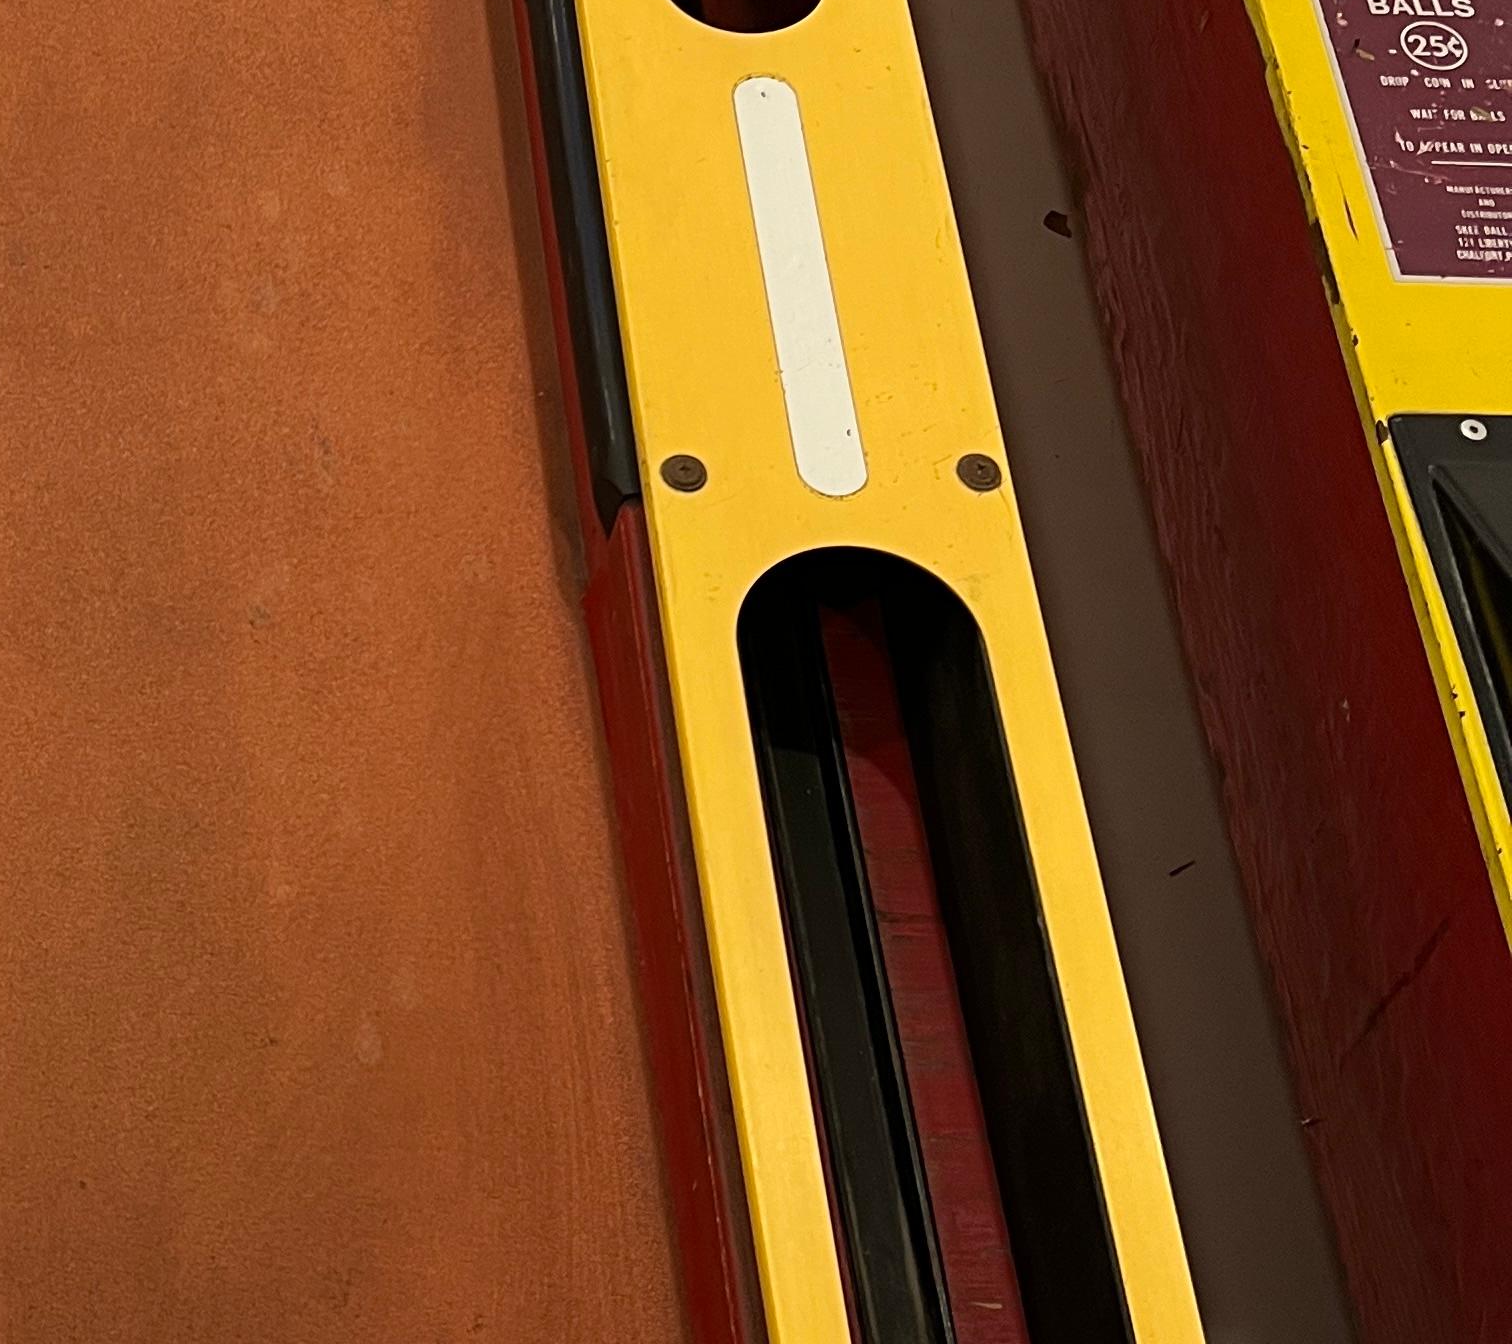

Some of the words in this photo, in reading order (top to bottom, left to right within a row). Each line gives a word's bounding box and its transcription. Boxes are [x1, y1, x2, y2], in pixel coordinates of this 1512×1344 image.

[1380, 75, 1409, 87] DROP
[1461, 78, 1475, 89] IN
[1443, 109, 1466, 121] FOR
[1469, 143, 1483, 154] IN
[1487, 143, 1512, 155] OPE
